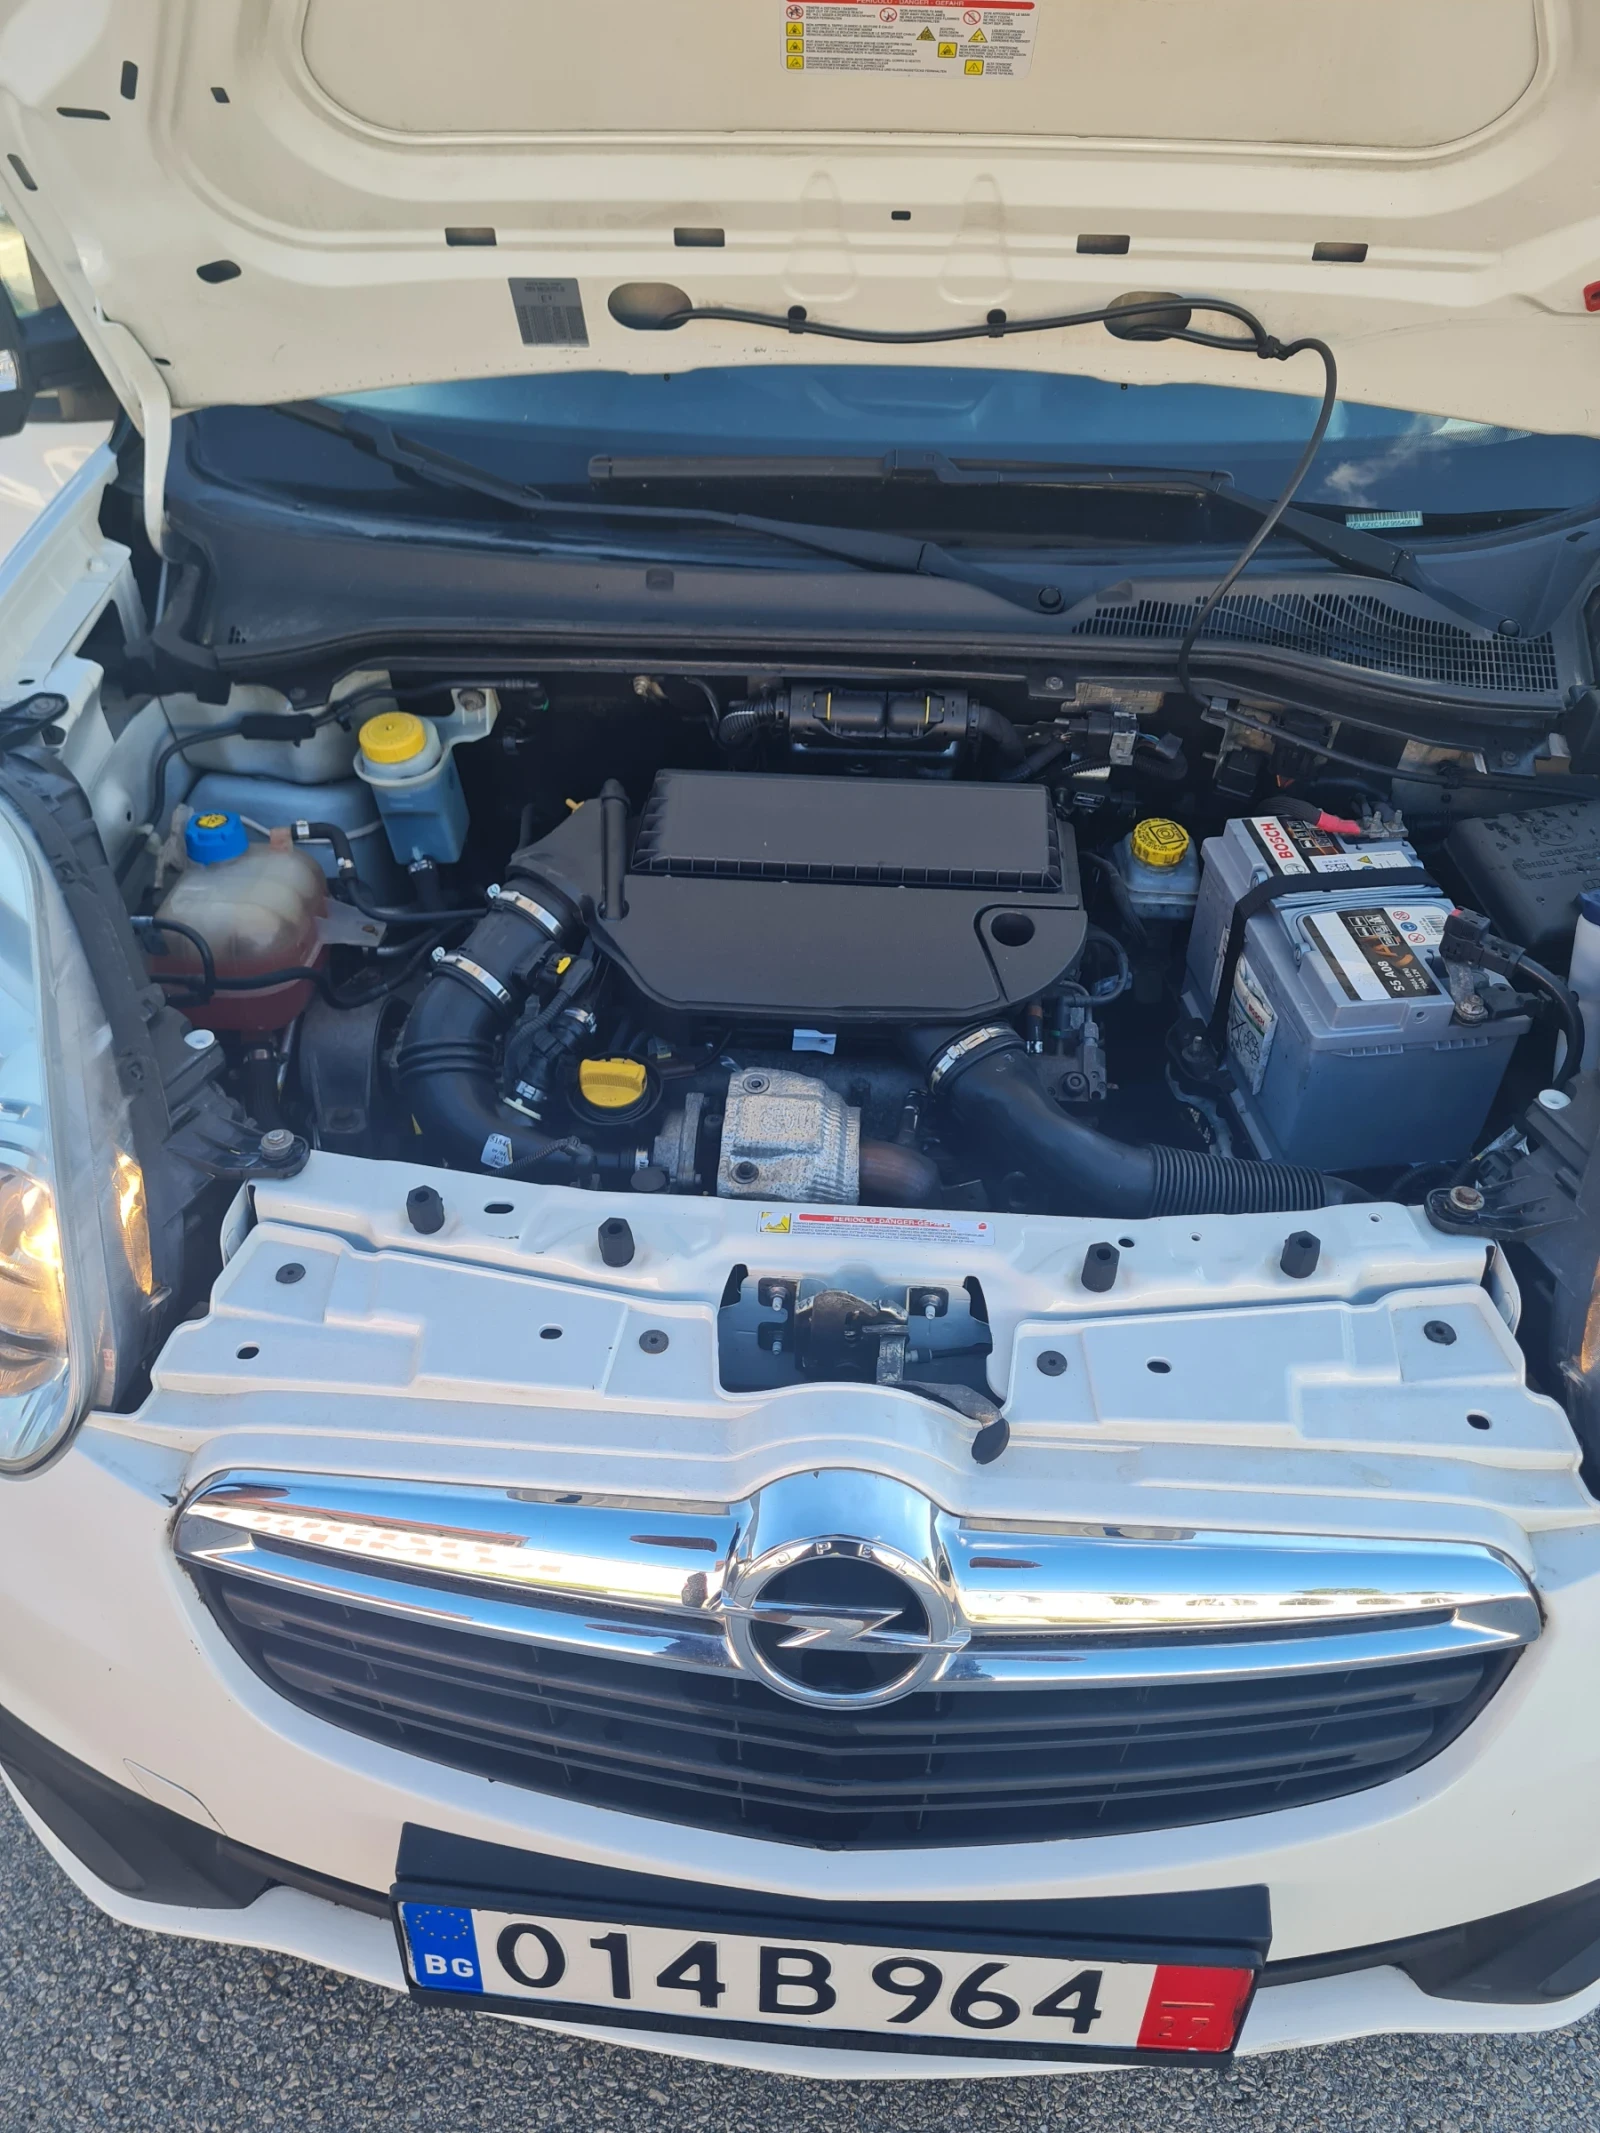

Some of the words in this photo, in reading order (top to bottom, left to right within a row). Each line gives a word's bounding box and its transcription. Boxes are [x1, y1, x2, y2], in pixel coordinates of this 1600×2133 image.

[1260, 822, 1295, 859] BOSCH
[1378, 961, 1397, 978] A08
[1390, 979, 1405, 991] S5
[776, 1541, 908, 1577] OPEL
[424, 1953, 475, 1978] BG
